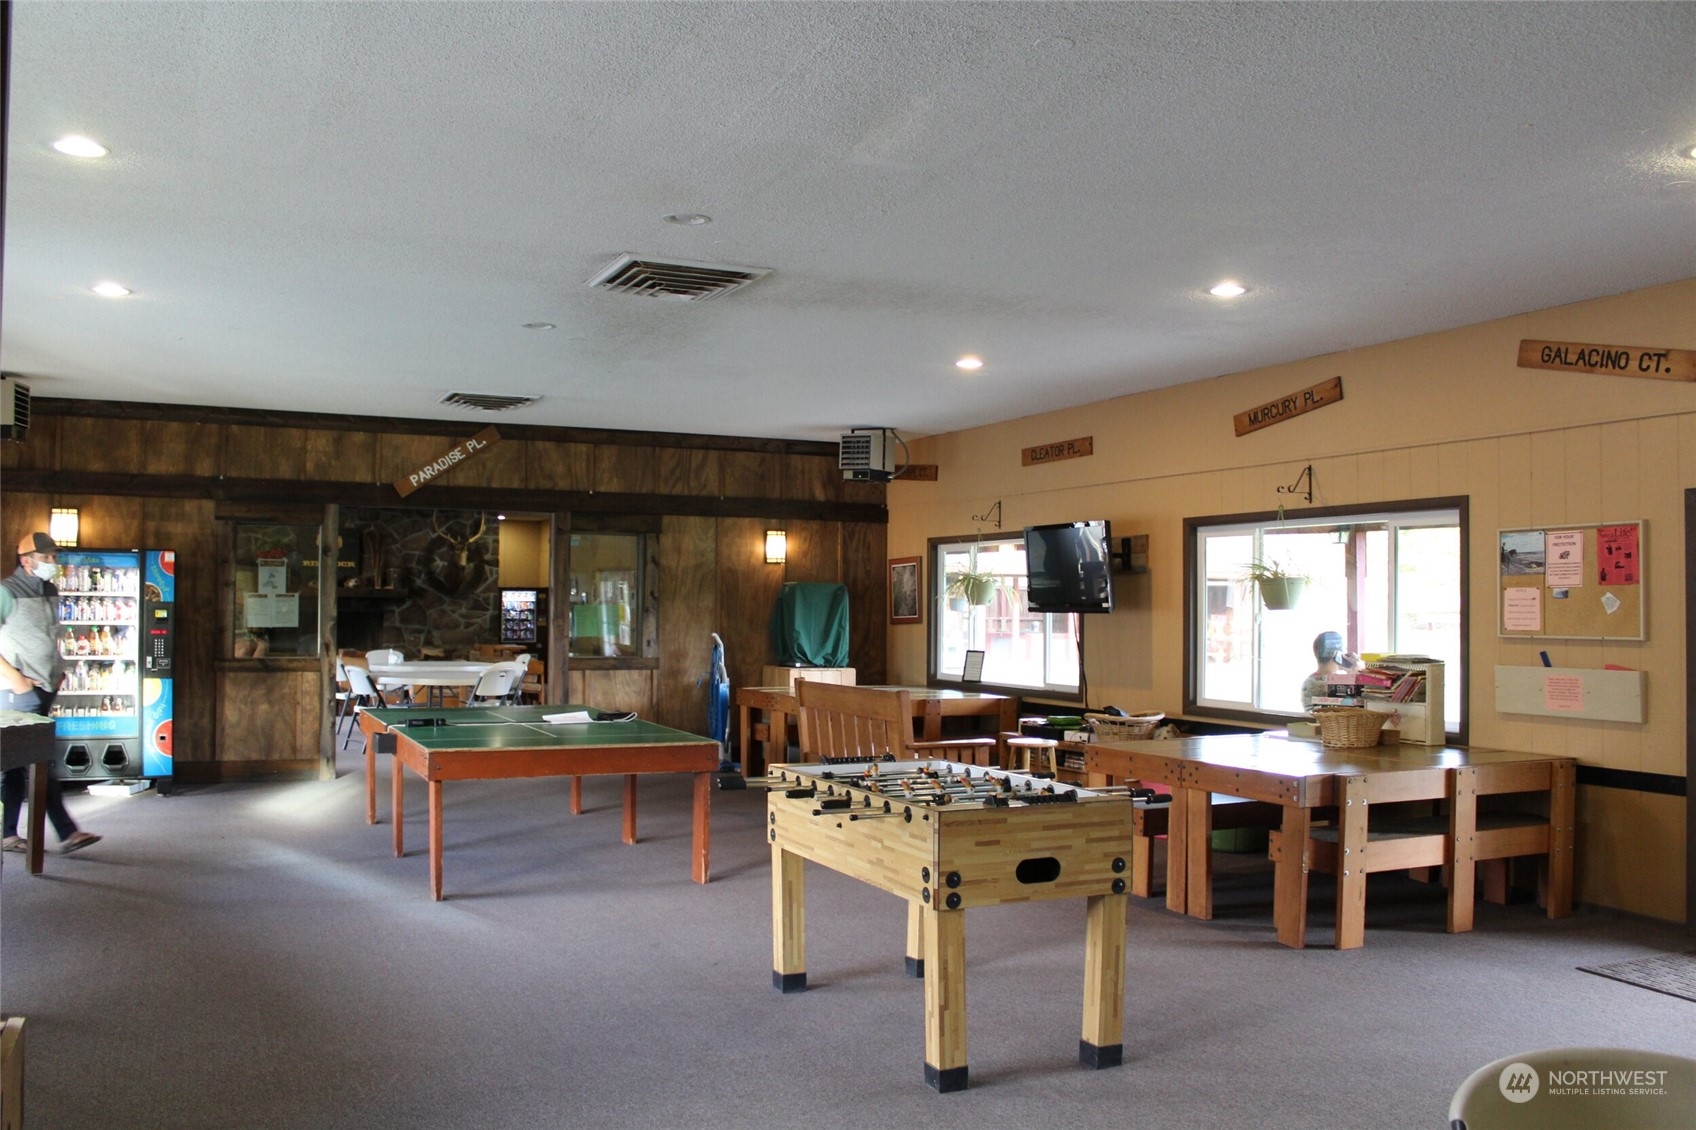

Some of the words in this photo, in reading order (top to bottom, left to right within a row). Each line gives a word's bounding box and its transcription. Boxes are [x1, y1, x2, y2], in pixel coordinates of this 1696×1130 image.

[1541, 345, 1630, 370] GALACINO
[1638, 352, 1671, 374] CT.
[1247, 396, 1298, 427] MURCURY
[1303, 389, 1324, 407] PL.
[409, 447, 466, 487] PARADISE
[465, 438, 487, 453] PL.
[1067, 442, 1081, 455] PL.
